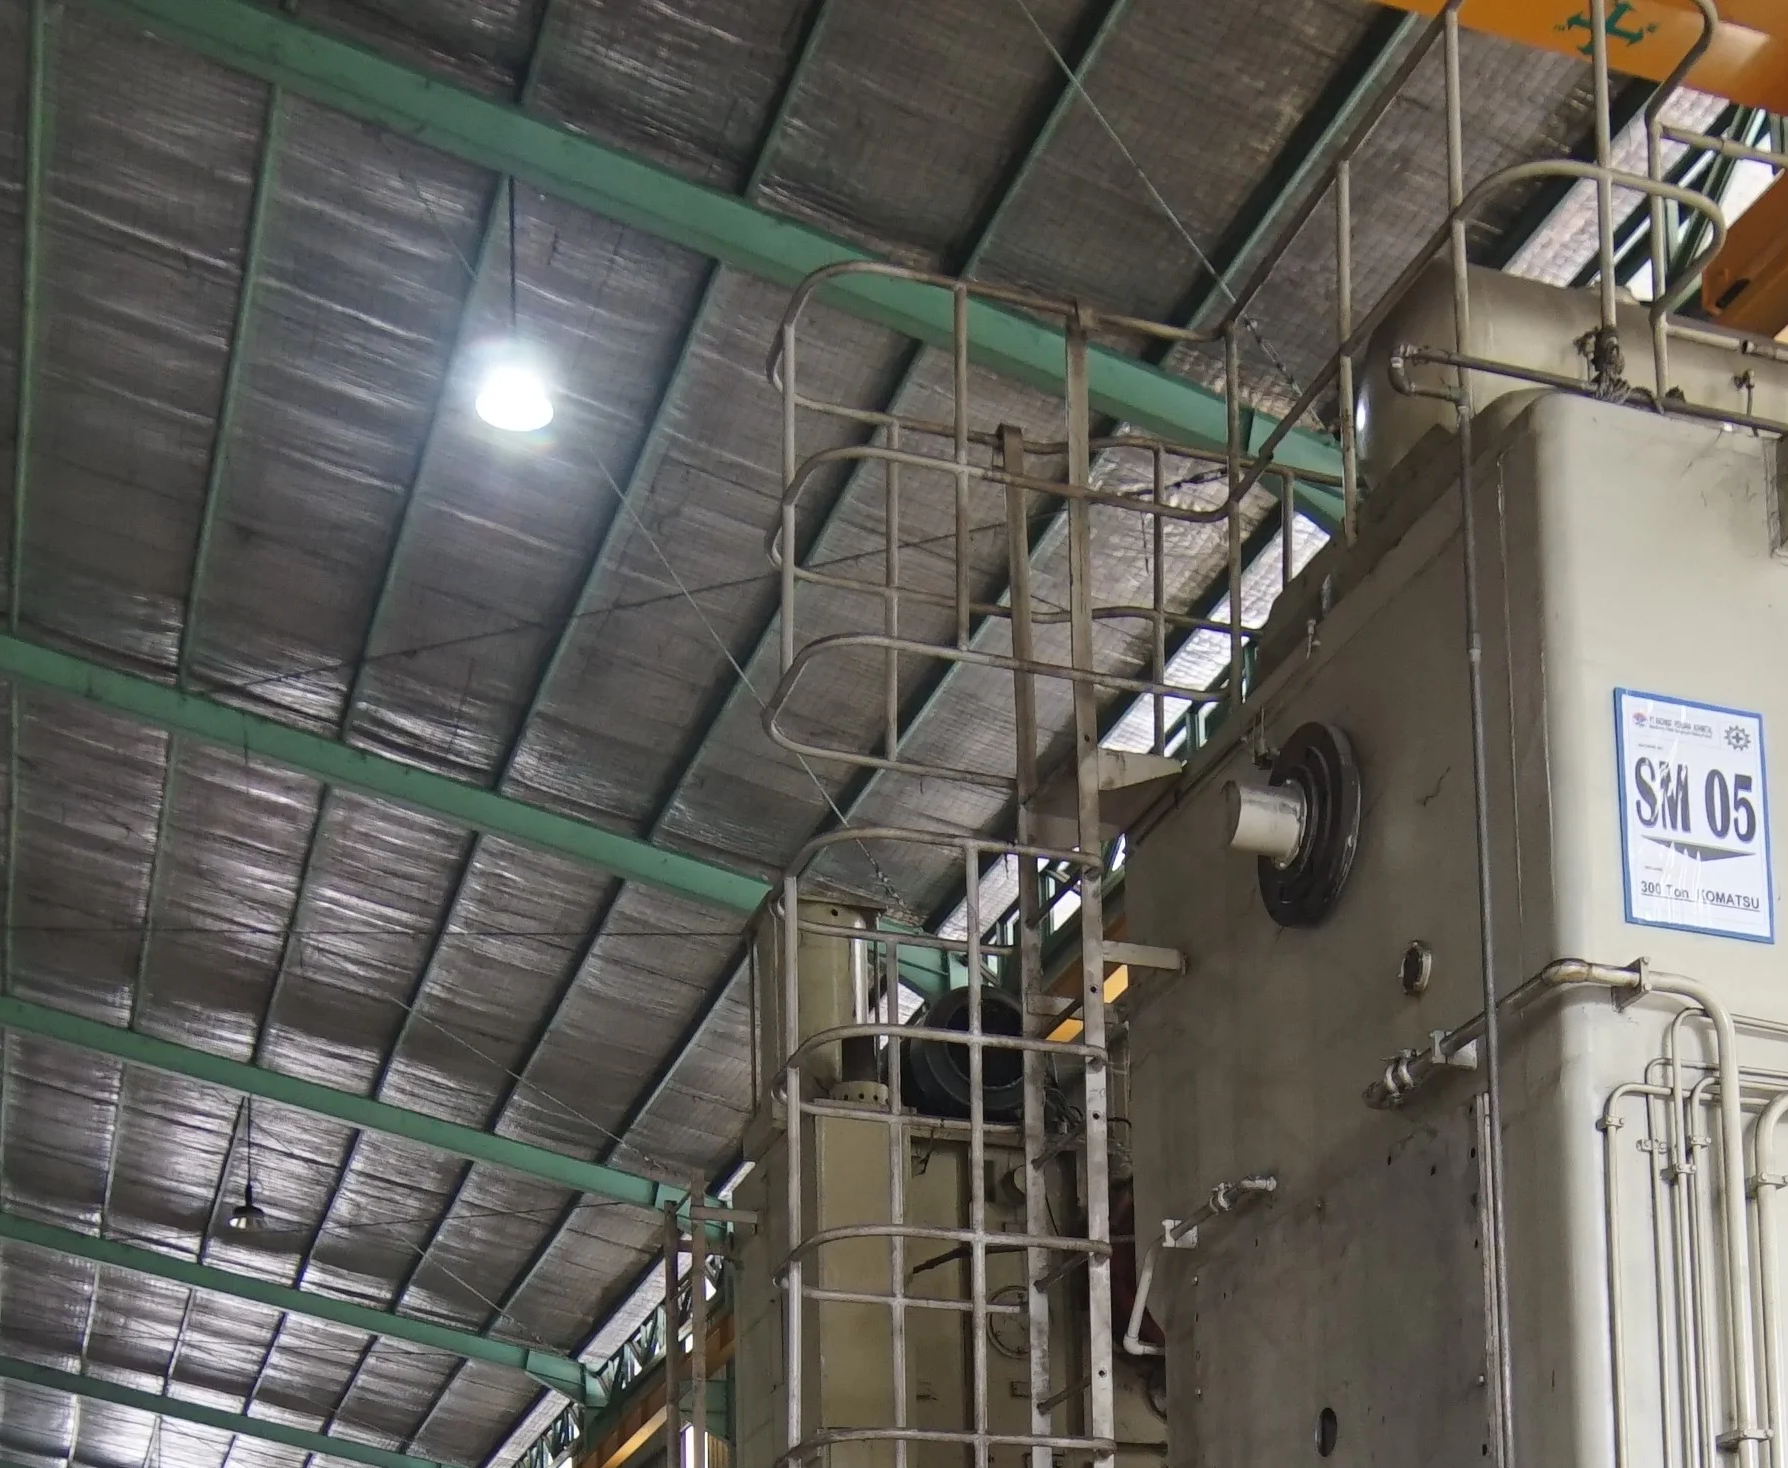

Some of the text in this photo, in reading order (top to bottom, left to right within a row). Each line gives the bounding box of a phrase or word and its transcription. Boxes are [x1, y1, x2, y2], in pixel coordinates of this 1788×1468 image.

[1634, 756, 1757, 844] SM 05
[1641, 880, 1760, 909] 300 Ton KOMATSU
